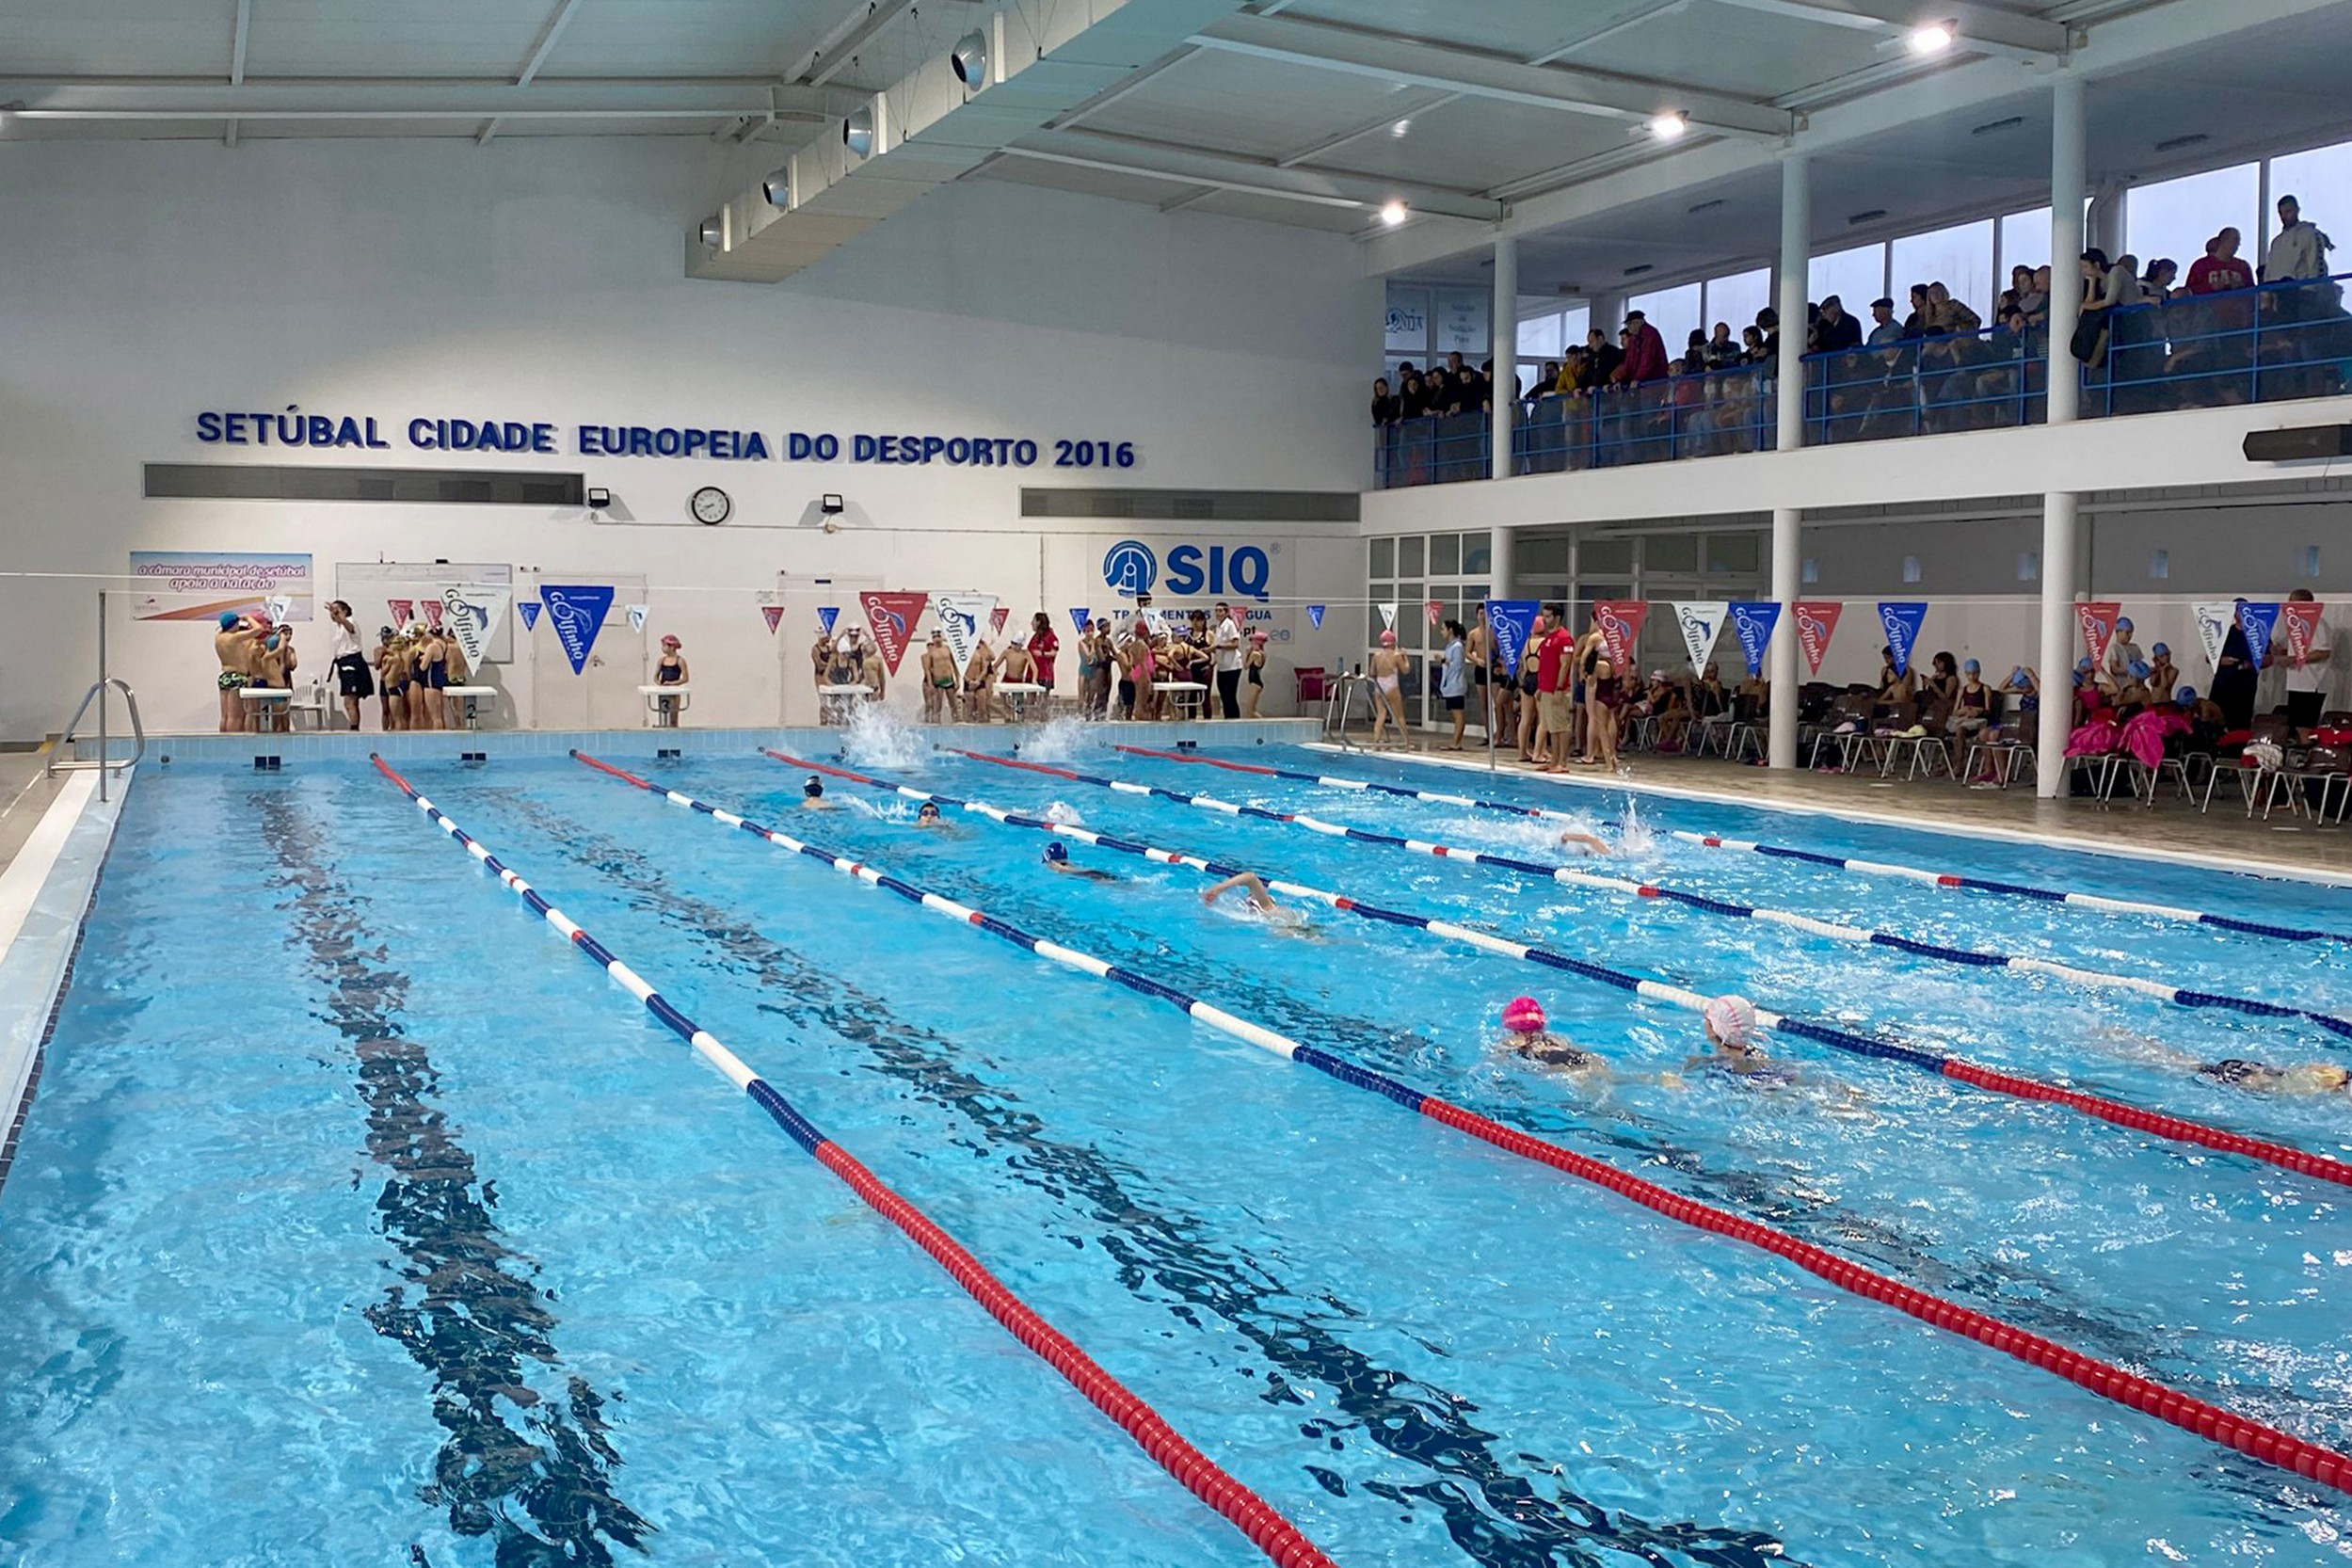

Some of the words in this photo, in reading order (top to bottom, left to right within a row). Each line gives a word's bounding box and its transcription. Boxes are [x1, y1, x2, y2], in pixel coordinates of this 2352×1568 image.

[197, 405, 388, 447] SETÚBAL
[408, 418, 553, 451] CIDADE
[579, 425, 769, 459] EUROPEIA
[789, 433, 839, 461] DO
[854, 435, 1037, 464] DESPORTO
[1055, 440, 1135, 468] 2016
[149, 564, 191, 577] câmara
[192, 565, 248, 578] municipal
[248, 565, 263, 577] de
[262, 566, 306, 577] setúbal
[1165, 544, 1270, 603] SIQ
[169, 578, 209, 592] apoia
[209, 579, 220, 589] a
[220, 578, 276, 591] natação
[466, 704, 476, 718] 2
[661, 699, 670, 713] 3
